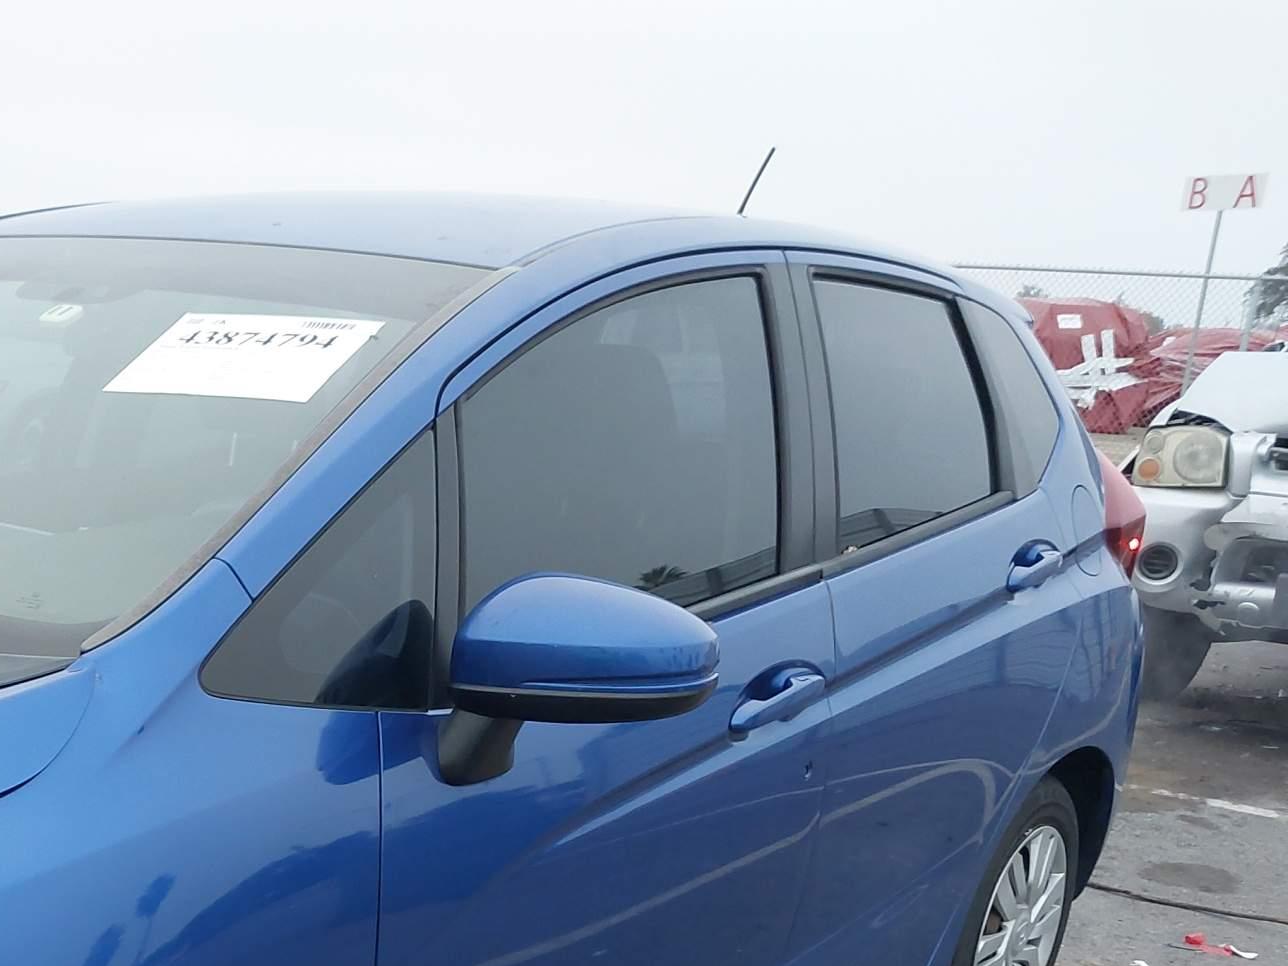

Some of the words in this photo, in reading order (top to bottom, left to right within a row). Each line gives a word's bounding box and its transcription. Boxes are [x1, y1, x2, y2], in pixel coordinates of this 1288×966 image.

[1188, 177, 1208, 209] B
[1232, 175, 1257, 208] A
[178, 329, 339, 349] 43874794
